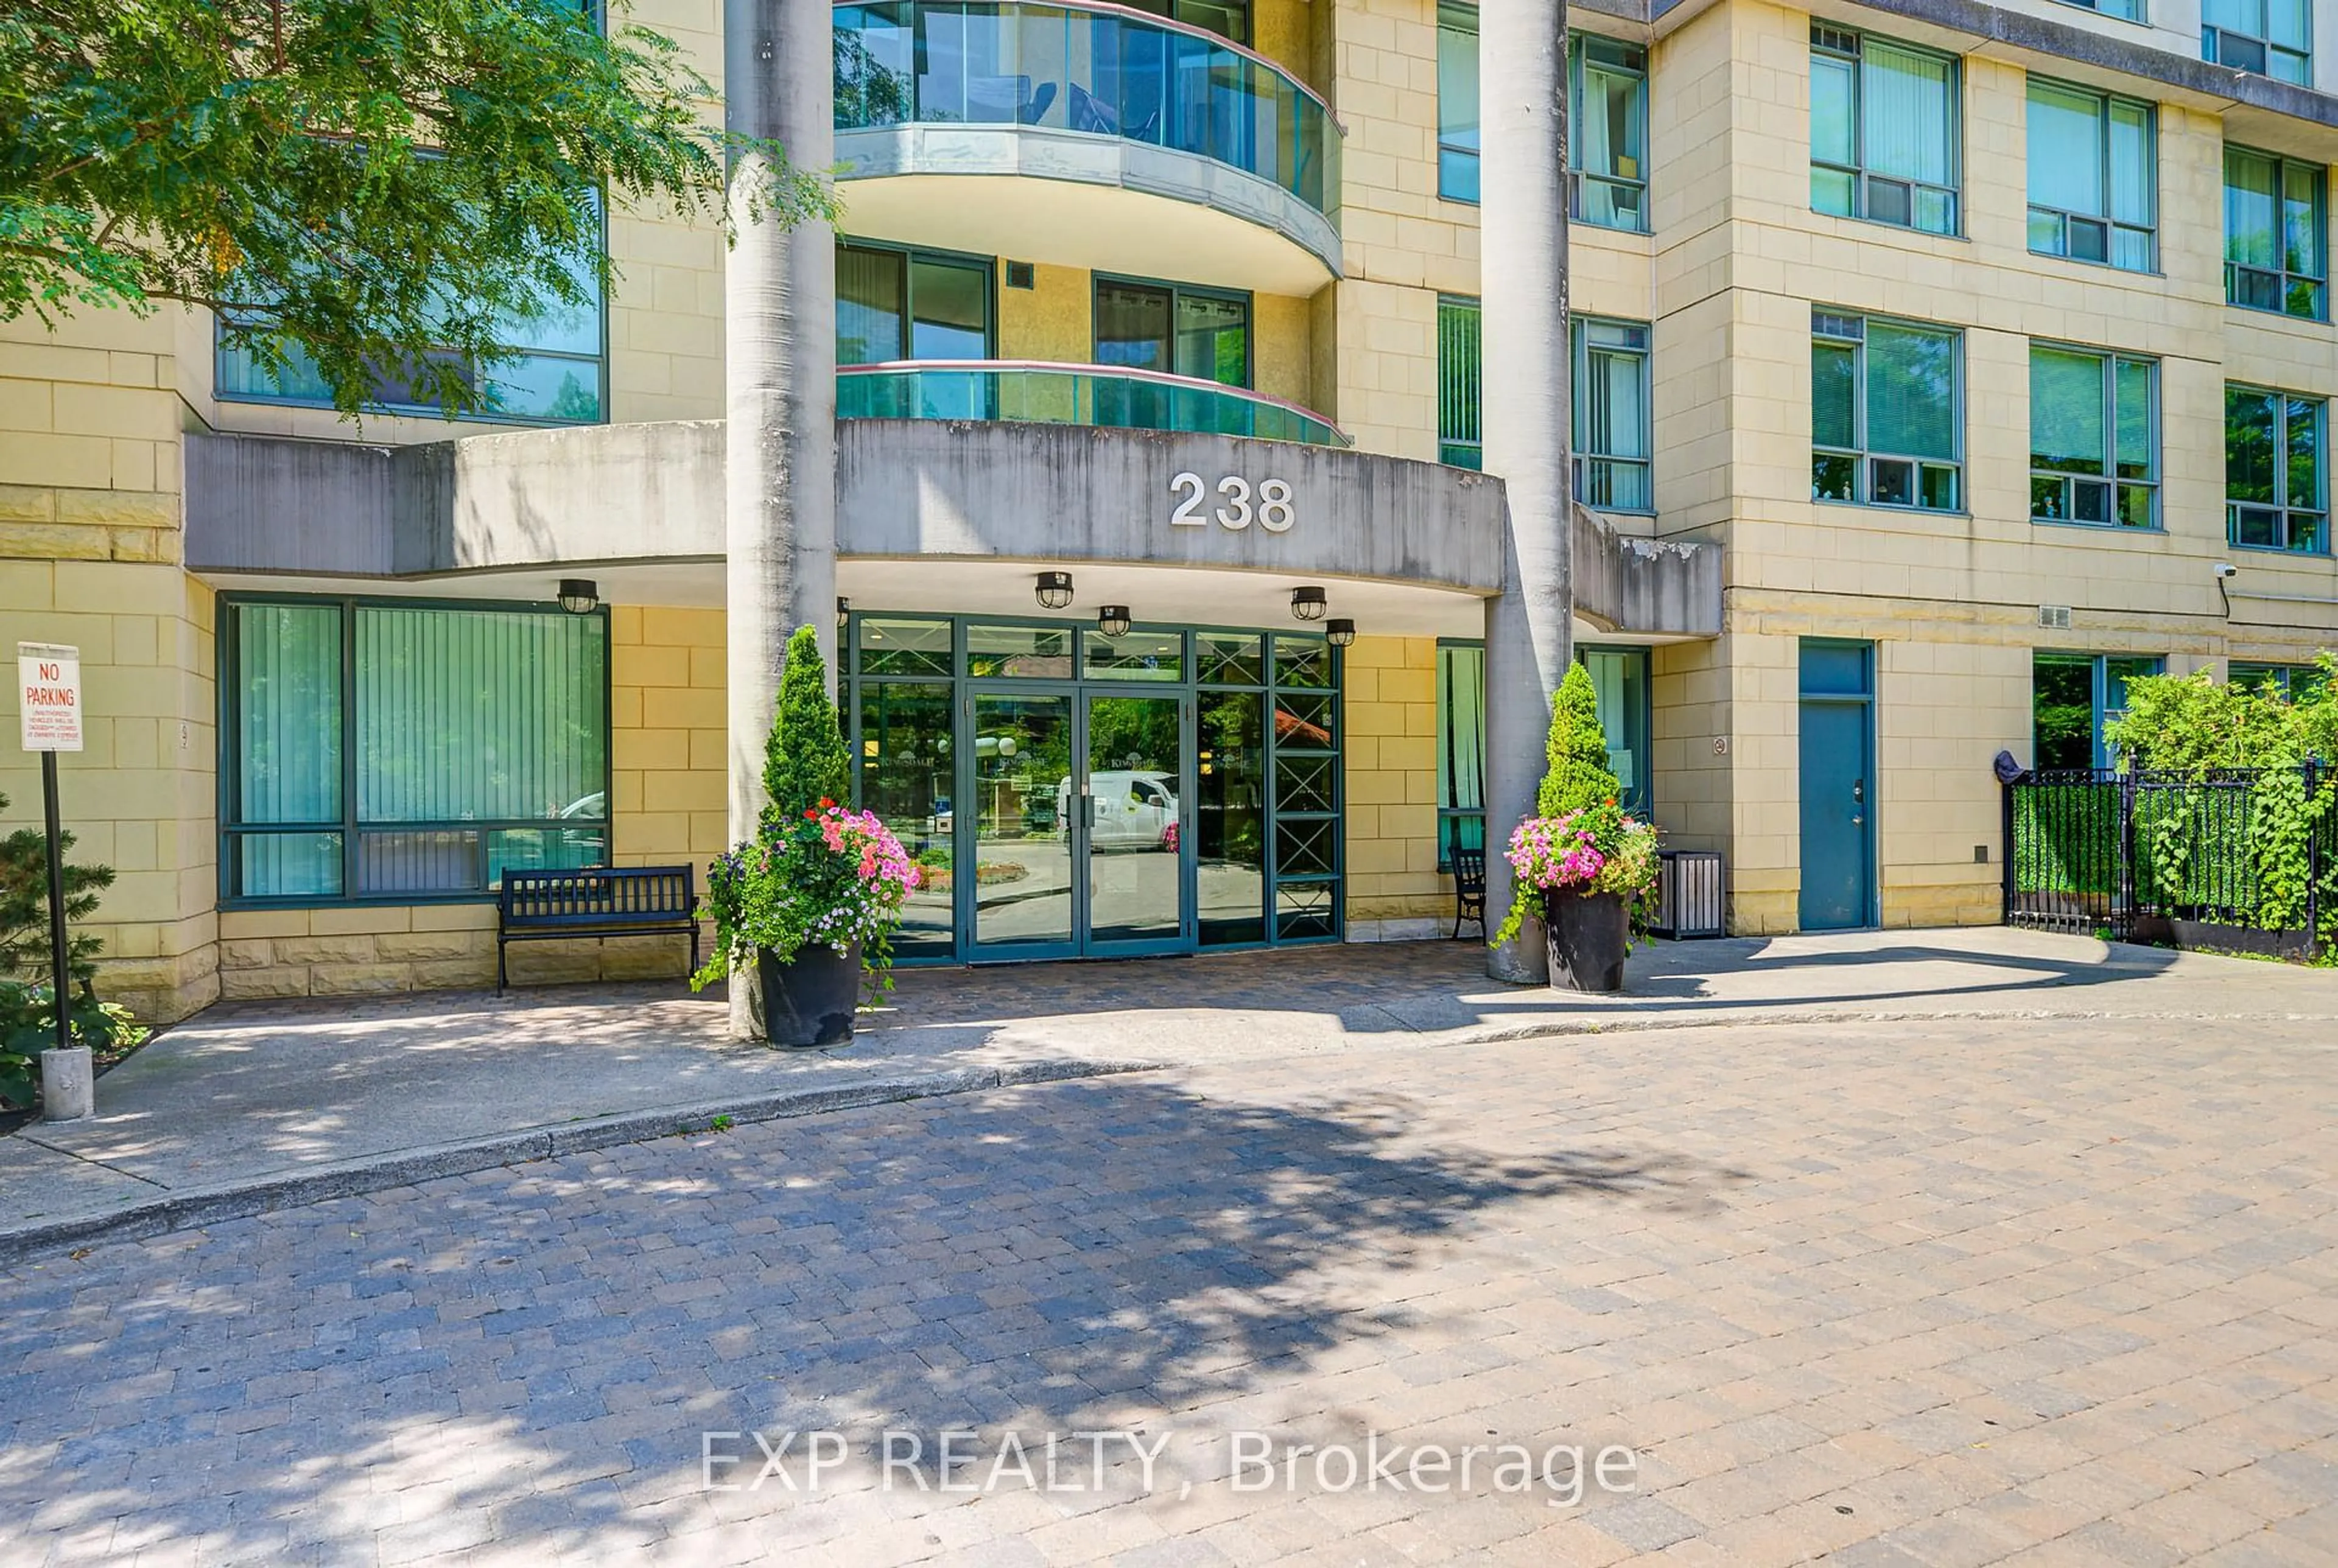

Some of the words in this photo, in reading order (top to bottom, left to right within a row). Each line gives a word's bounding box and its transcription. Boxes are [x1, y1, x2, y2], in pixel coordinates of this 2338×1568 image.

[1170, 472, 1295, 533] 238
[40, 663, 59, 681] NO
[26, 687, 74, 706] PARKING
